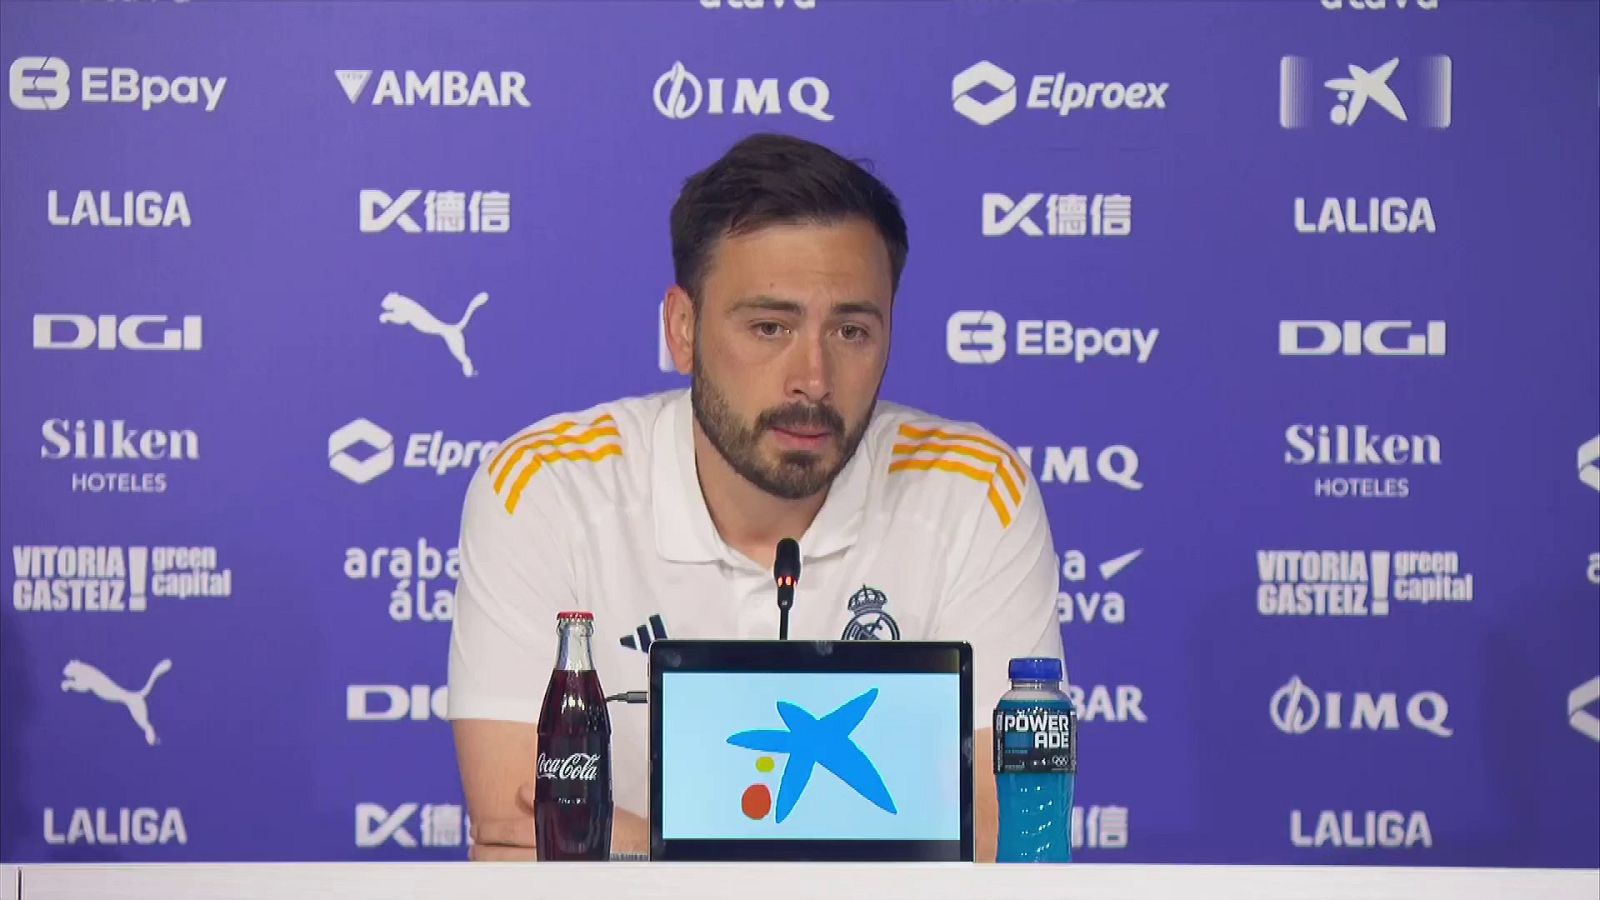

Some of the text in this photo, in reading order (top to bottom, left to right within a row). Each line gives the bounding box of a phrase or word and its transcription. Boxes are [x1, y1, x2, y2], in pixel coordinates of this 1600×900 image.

[81, 67, 227, 111] EBpay
[371, 69, 531, 107] AMBAR
[708, 76, 835, 121] IMQ
[1026, 73, 1169, 115] Elproex
[47, 190, 192, 228] LALIGA
[1294, 197, 1436, 233] LALIGA
[33, 314, 202, 351] DIGI
[1016, 320, 1160, 363] EBpay
[1279, 320, 1446, 355] DIGI
[41, 418, 199, 460] Silken
[1284, 424, 1441, 464] Silken
[72, 473, 167, 492] HOTELES
[1315, 478, 1409, 496] HOTELES
[13, 546, 125, 578] VITORIA
[152, 547, 216, 571] green
[1257, 551, 1368, 582] VITORIA
[1394, 552, 1458, 576] green
[13, 579, 125, 611] GASTEIZ
[152, 568, 232, 599] capital
[389, 578, 455, 621] ála
[1257, 583, 1368, 615] GASTEIZ
[1394, 574, 1473, 604] capital
[1069, 685, 1148, 722] BAR
[1326, 692, 1452, 736] IMQ
[1005, 714, 1069, 732] POWER
[1034, 732, 1070, 748] ADE
[44, 808, 187, 844] LALIGA
[1291, 811, 1431, 846] LALIGA
